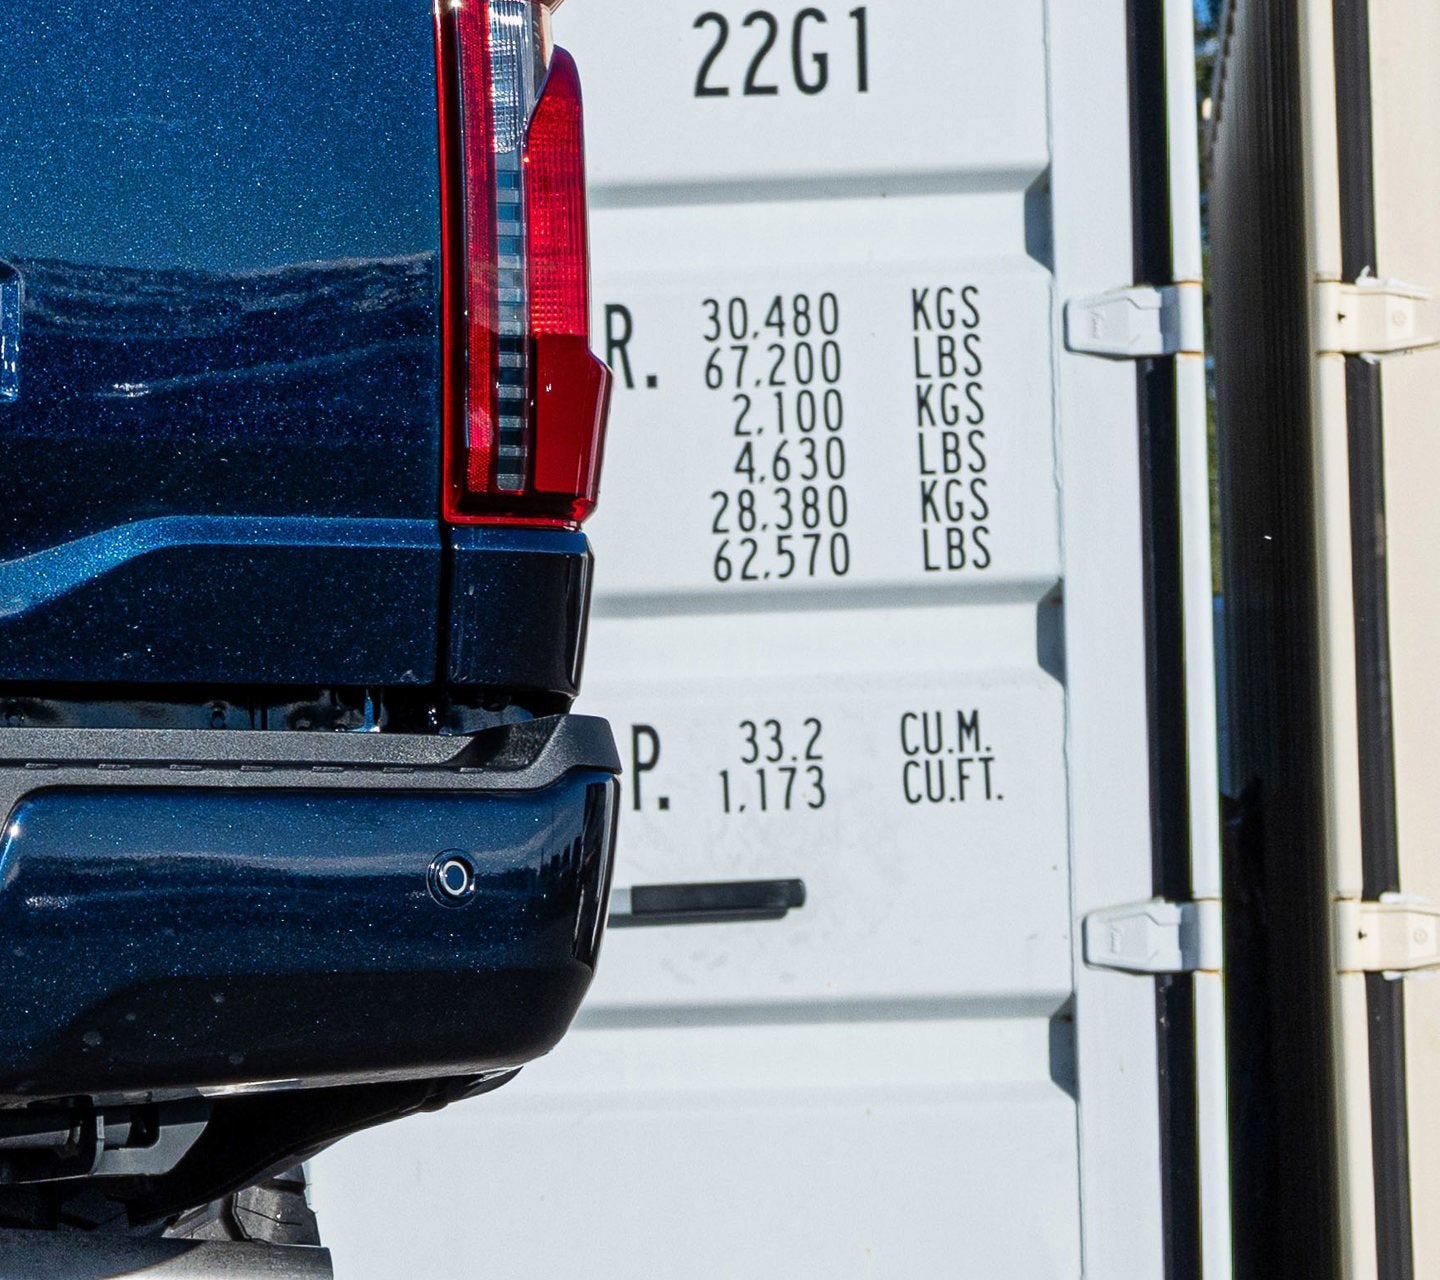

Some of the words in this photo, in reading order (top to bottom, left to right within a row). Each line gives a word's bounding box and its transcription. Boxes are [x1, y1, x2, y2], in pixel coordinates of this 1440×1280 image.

[692, 6, 868, 98] 22G1
[701, 292, 840, 342] 30,480
[911, 285, 981, 331] KGS
[705, 340, 842, 390] 67,200
[914, 334, 983, 380] LBS
[732, 388, 844, 437] 2,100
[916, 382, 985, 428] KGS
[734, 436, 846, 484] 4,630
[918, 429, 988, 476] LBS
[710, 484, 848, 535] 28,380
[920, 477, 990, 524] KGS
[713, 532, 851, 583] 62,570
[922, 525, 992, 572] LBS
[738, 718, 824, 764] 33.2
[900, 709, 993, 756] CU.M.
[630, 724, 670, 811] P.
[718, 766, 827, 814] 1,173
[902, 756, 1005, 804] CU.FT.
